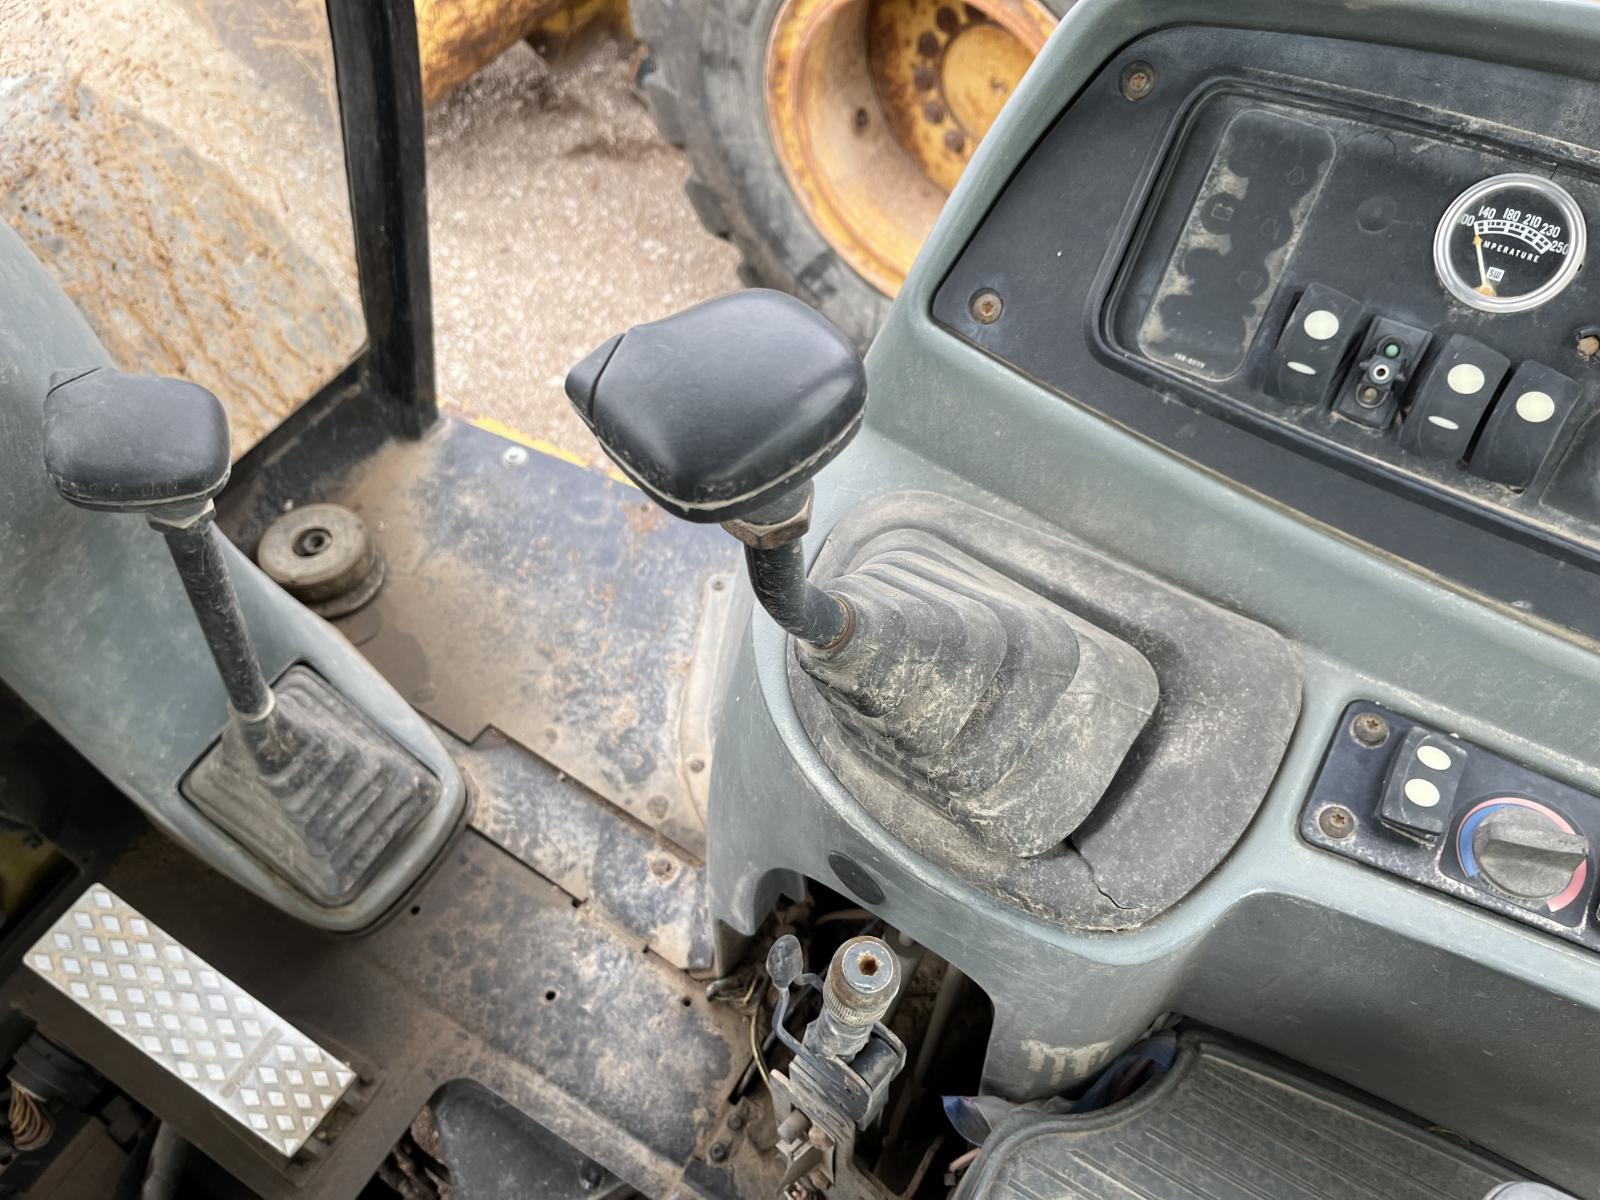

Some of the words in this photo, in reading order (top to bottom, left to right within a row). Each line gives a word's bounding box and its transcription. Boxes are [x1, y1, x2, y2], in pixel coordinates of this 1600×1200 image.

[1478, 205, 1497, 220] 140
[1503, 207, 1522, 222] 180
[1523, 214, 1542, 228] 210
[1540, 223, 1561, 238] 230
[1482, 240, 1540, 263] MPERATURE
[1550, 240, 1569, 255] 250
[1488, 268, 1503, 280] SW
